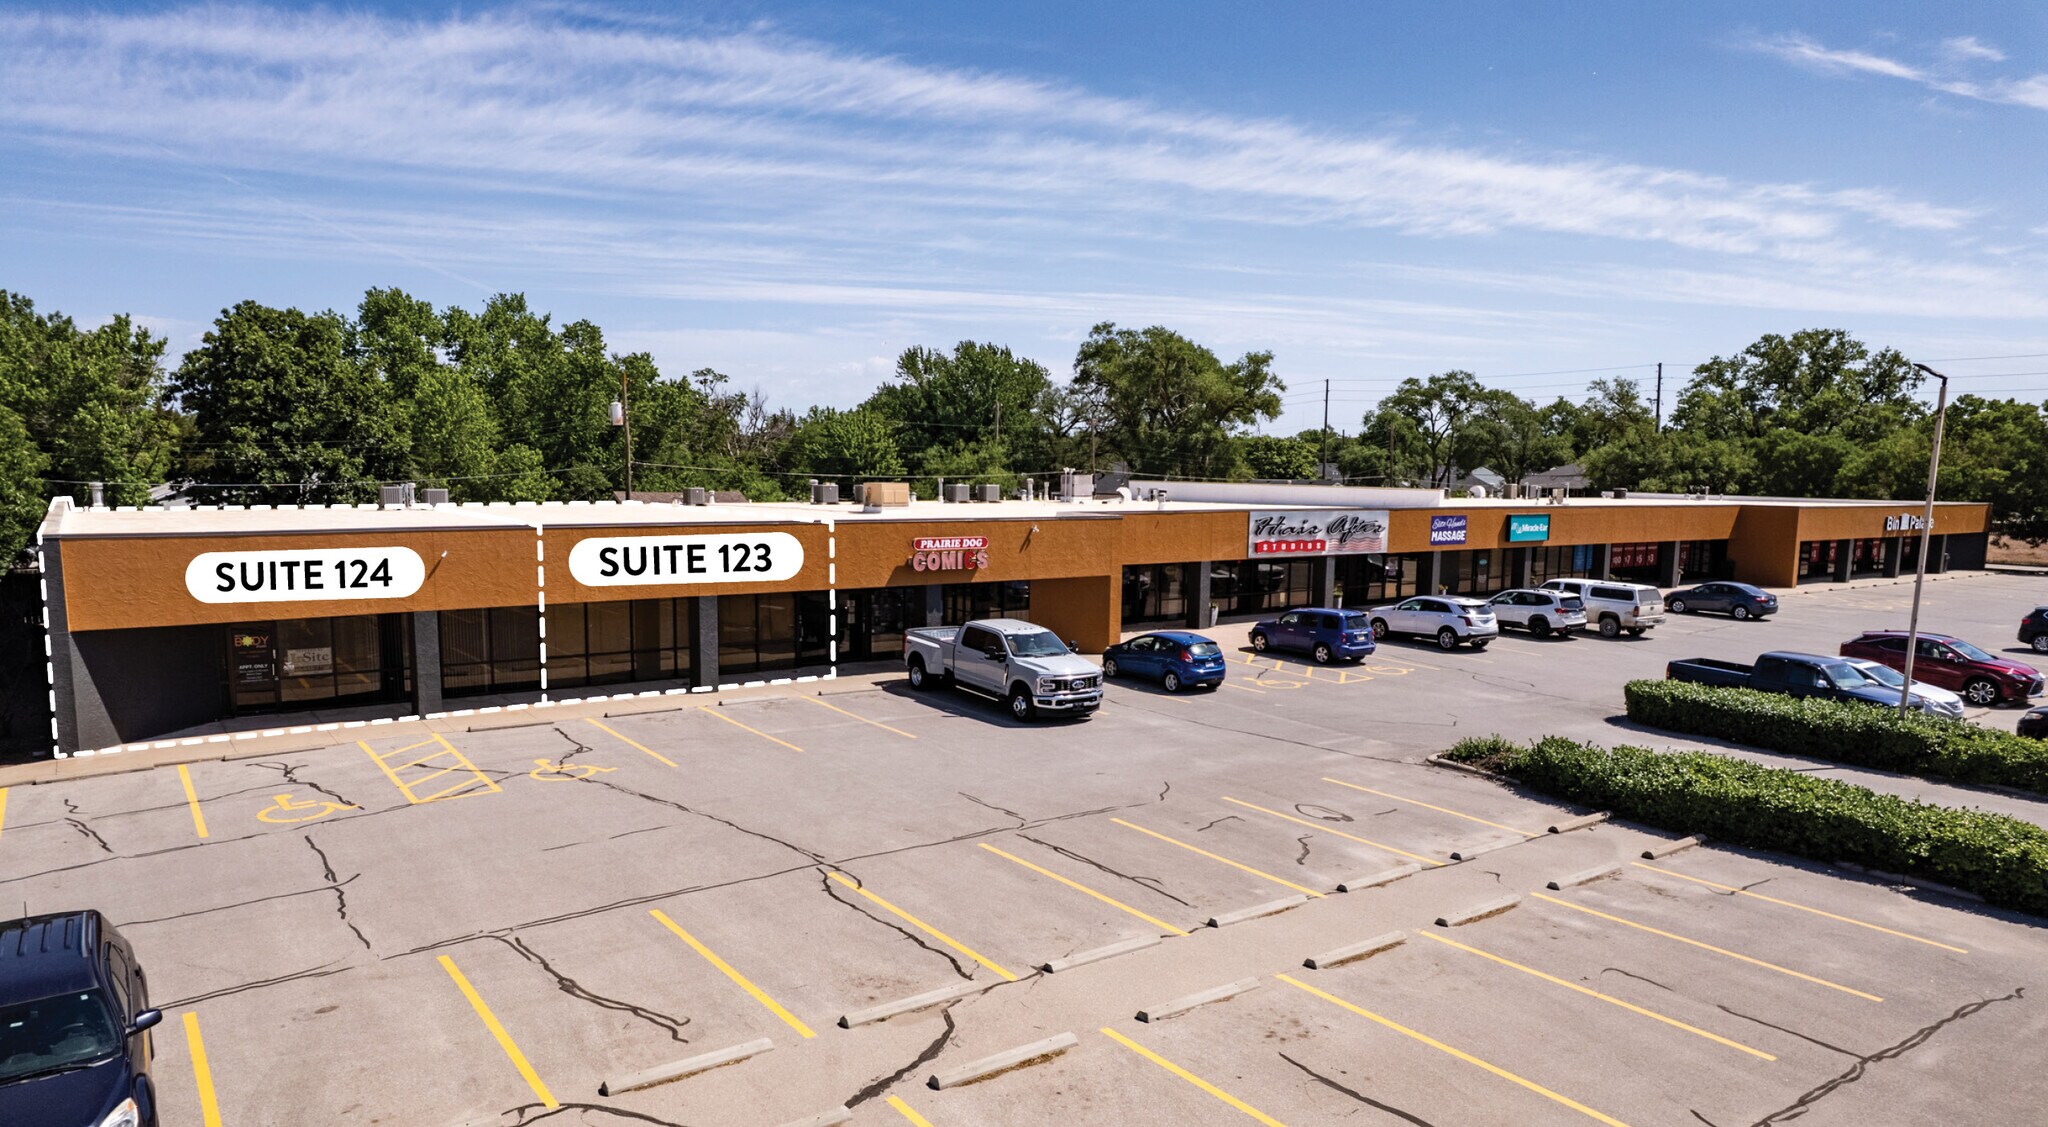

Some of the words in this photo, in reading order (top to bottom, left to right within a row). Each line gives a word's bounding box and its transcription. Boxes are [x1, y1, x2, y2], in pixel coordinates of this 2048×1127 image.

[1255, 516, 1322, 536] Hair
[1326, 515, 1386, 544] After
[1886, 516, 1900, 531] Bin
[1910, 515, 1934, 530] Palae
[1431, 530, 1466, 542] MASSAGE
[920, 539, 961, 549] PRAIRIE
[962, 538, 983, 547] DOG
[1263, 542, 1321, 551] STUDIOS
[912, 549, 988, 572] COMICS
